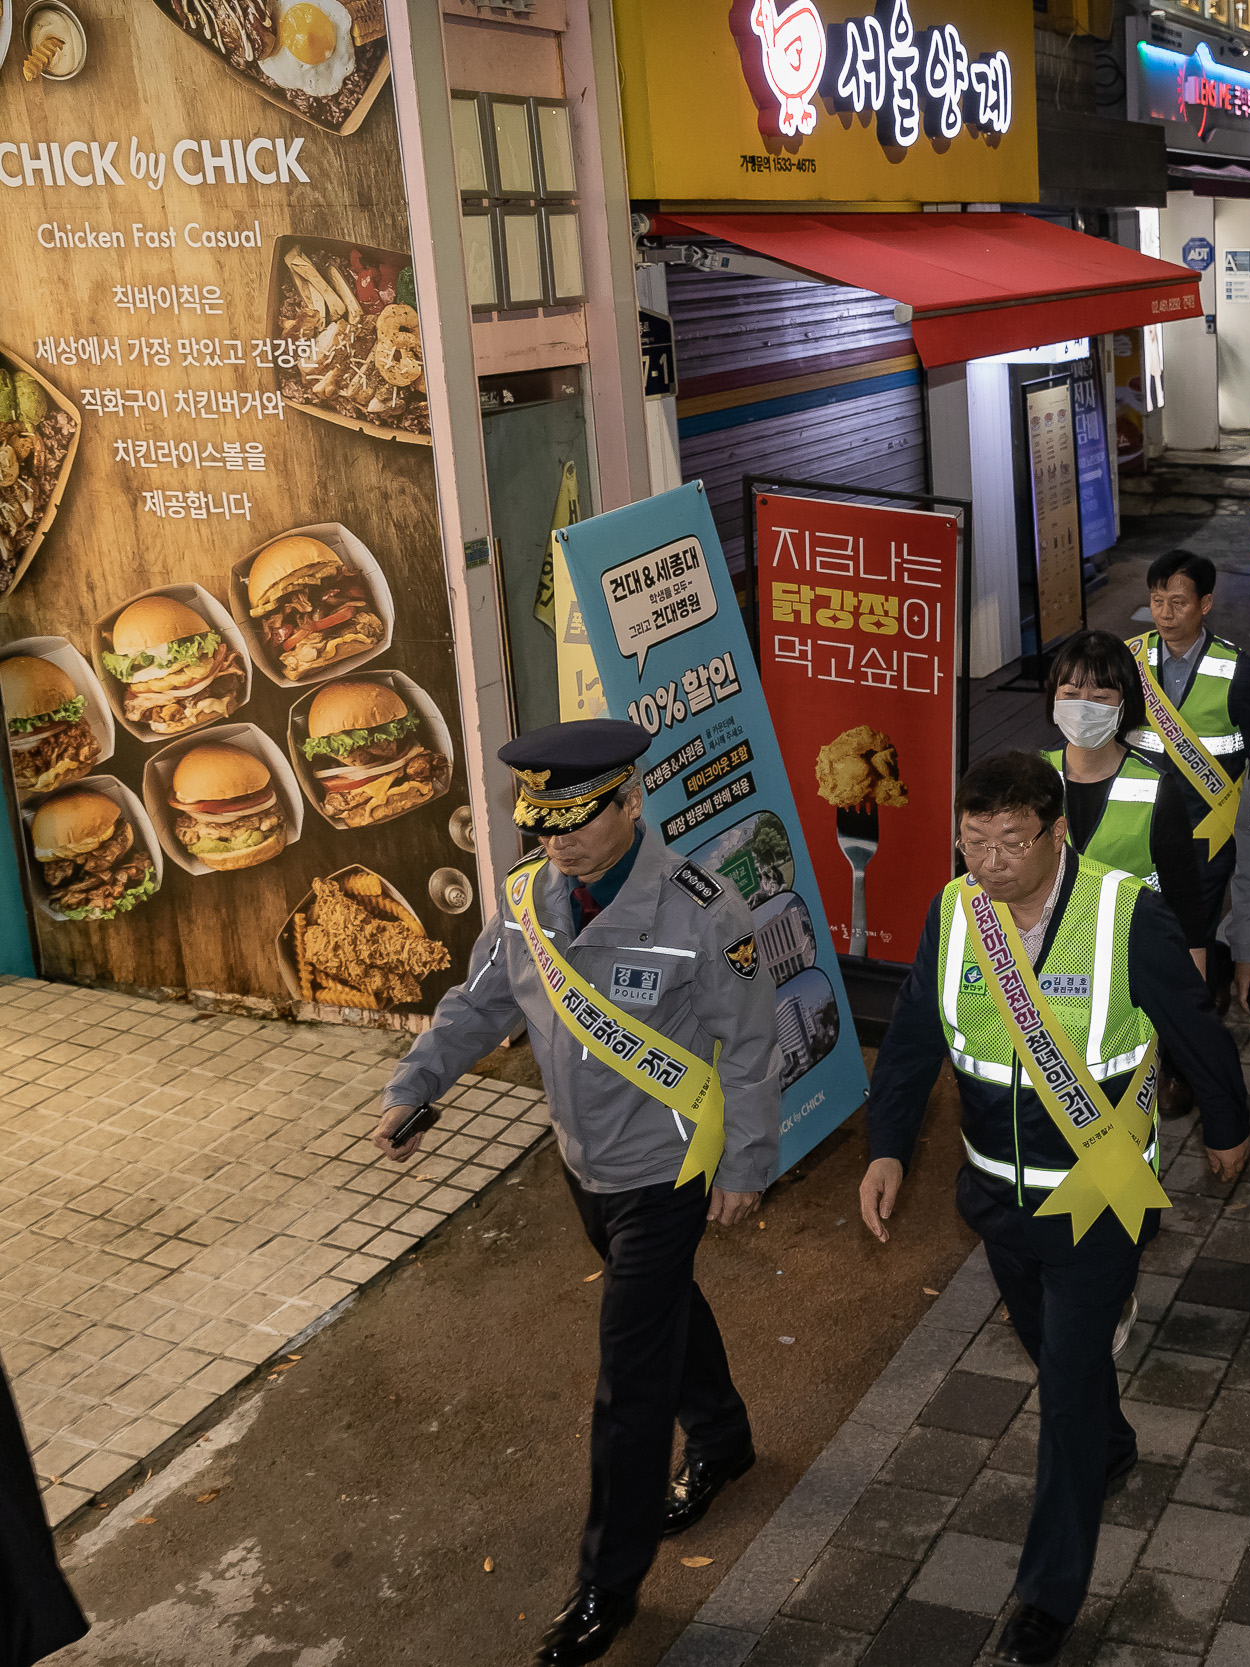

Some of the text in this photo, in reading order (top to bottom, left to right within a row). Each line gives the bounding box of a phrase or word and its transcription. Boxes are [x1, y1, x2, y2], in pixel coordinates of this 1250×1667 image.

[0, 136, 311, 190] CHICK by CHICK
[740, 154, 771, 173] 가맹문의
[37, 221, 262, 249] Chicken Fast Casual
[1188, 248, 1209, 261] ADT
[112, 285, 224, 315] 칙바이칙은
[36, 336, 319, 369] 세상에서 가장 맛있고 건강한
[80, 388, 285, 420] 직화구이 치킨버거와
[113, 440, 266, 471] 치킨라이스볼을
[143, 490, 252, 521] 제공합니다
[771, 526, 942, 588] 지금나는
[649, 587, 673, 604] 학생들
[628, 592, 701, 639] 그리고 건대병원
[772, 581, 941, 643] 닭강정이
[774, 635, 944, 695] 먹고싶다
[627, 651, 742, 739] 10% 할인
[1152, 704, 1185, 743] 건전한
[1200, 767, 1226, 795] 거리
[687, 745, 749, 792] 테이크아웃 포함
[667, 777, 750, 836] 매장 방문에 한해 적용
[615, 988, 654, 1001] POLICE
[963, 984, 983, 992] 광진구
[1053, 986, 1088, 994] 광진구청장
[970, 891, 1101, 1129] 안전하고 건전한 청년의 거리
[561, 986, 645, 1061] 건대맛의
[636, 1047, 688, 1090] 거리
[800, 1090, 826, 1117] CHICK
[1082, 1123, 1114, 1148] 광진경찰서
